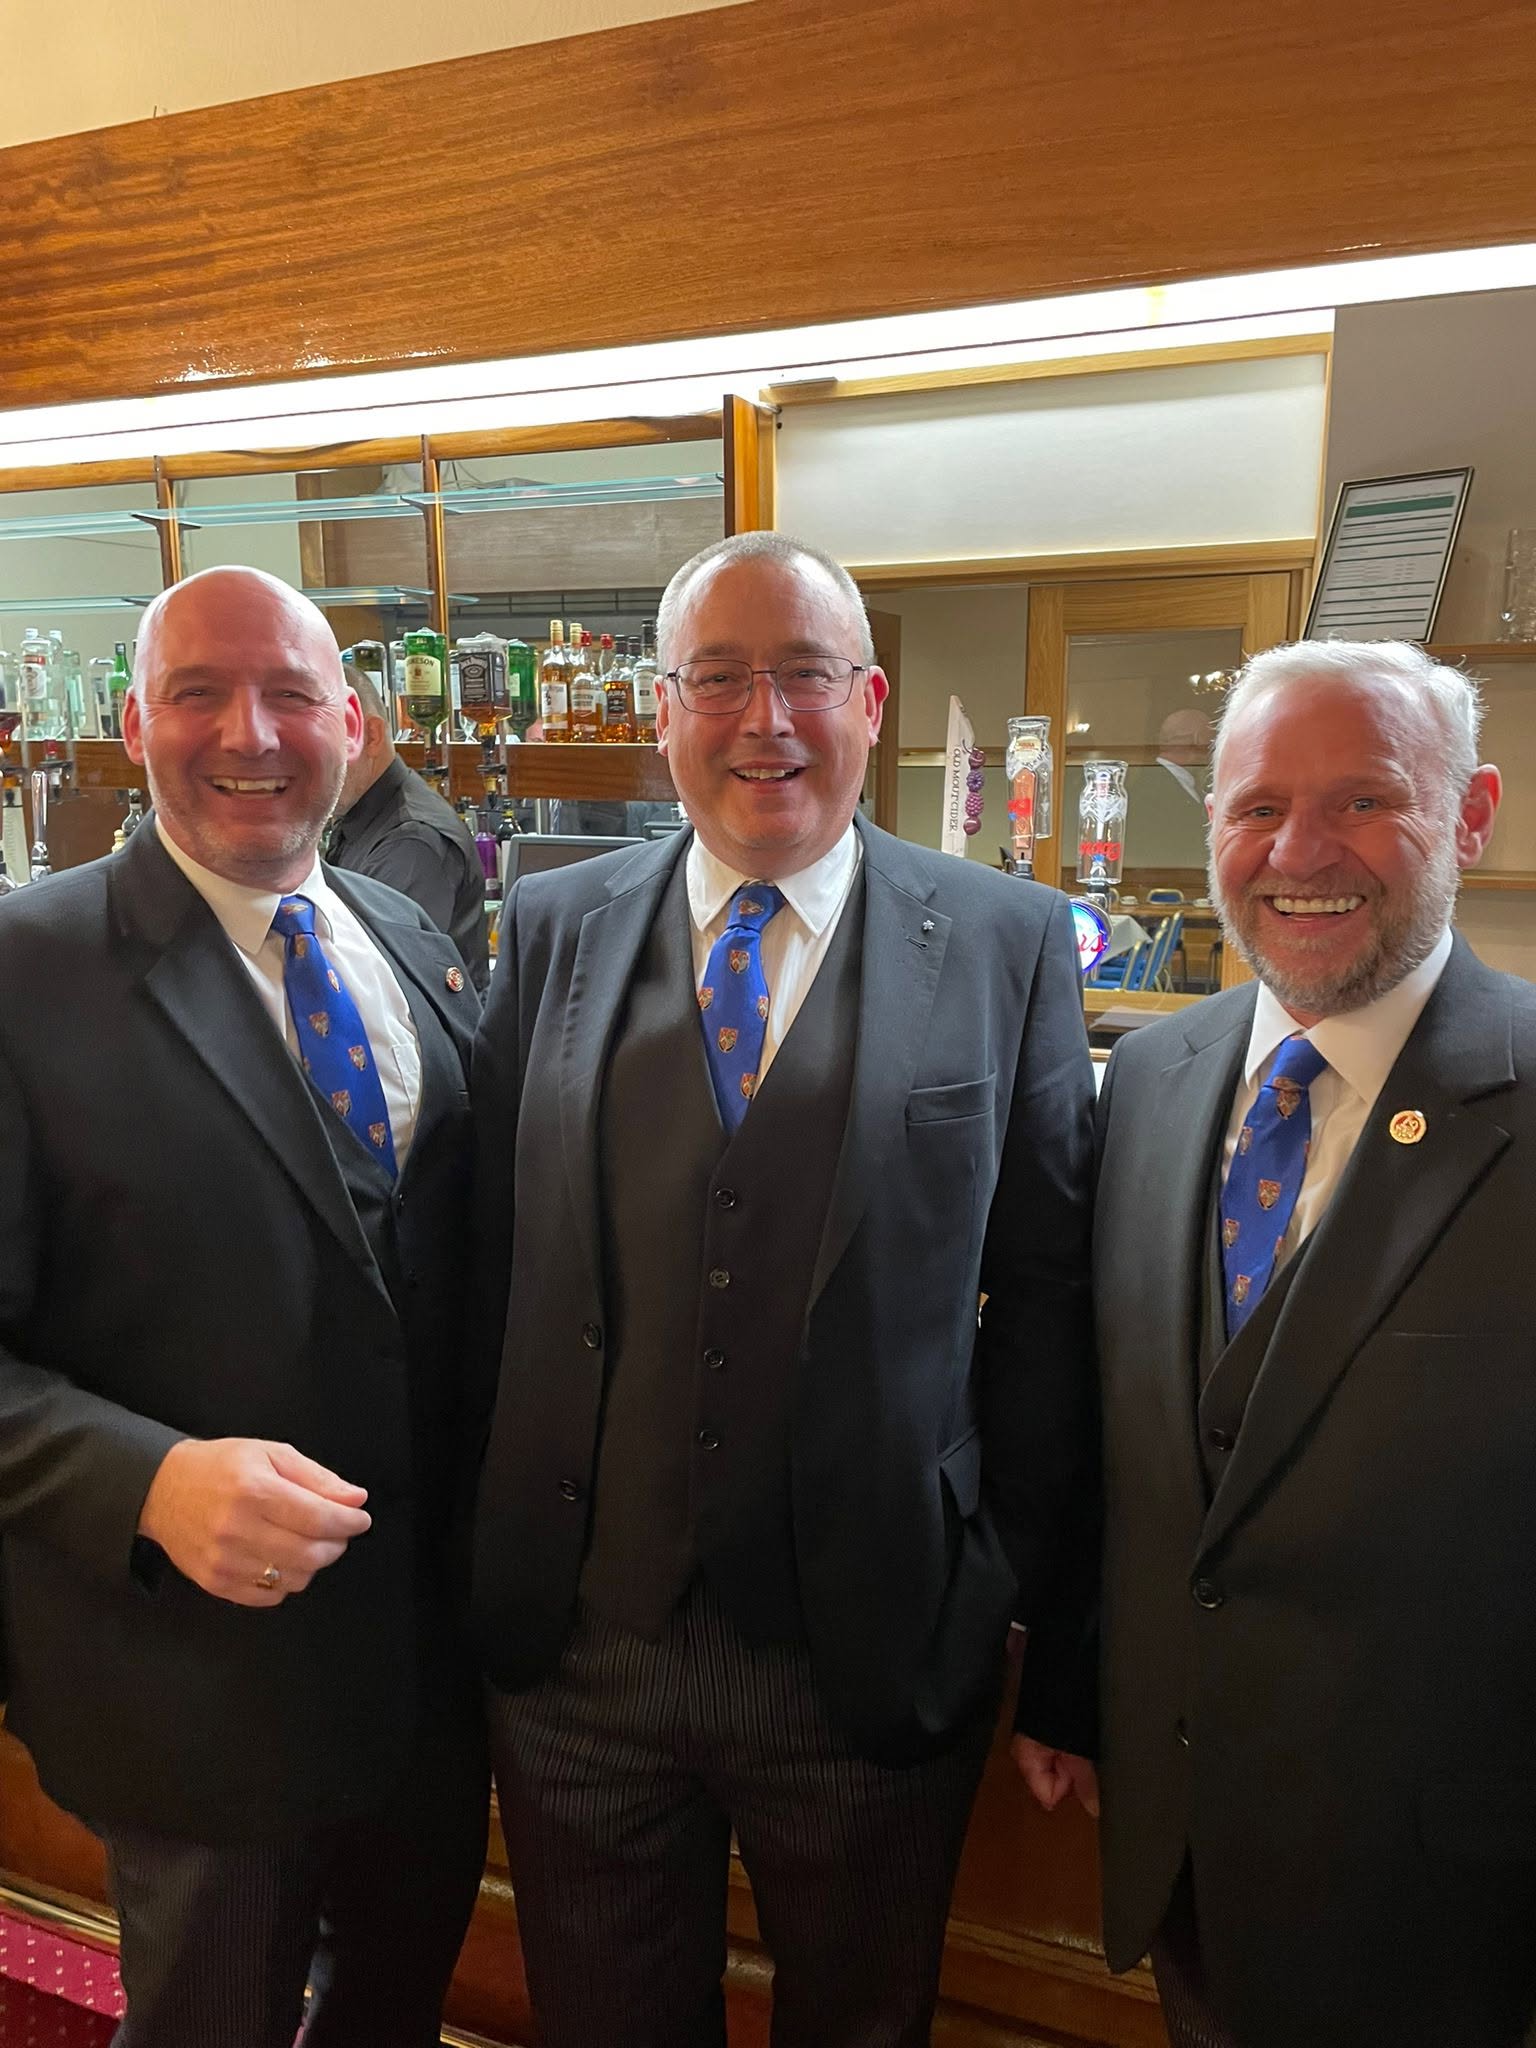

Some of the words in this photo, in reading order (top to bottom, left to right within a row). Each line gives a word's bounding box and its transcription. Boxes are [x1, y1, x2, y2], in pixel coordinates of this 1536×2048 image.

[953, 748, 961, 769] OLD
[951, 769, 960, 801] MOUT
[949, 802, 959, 832] CIDER
